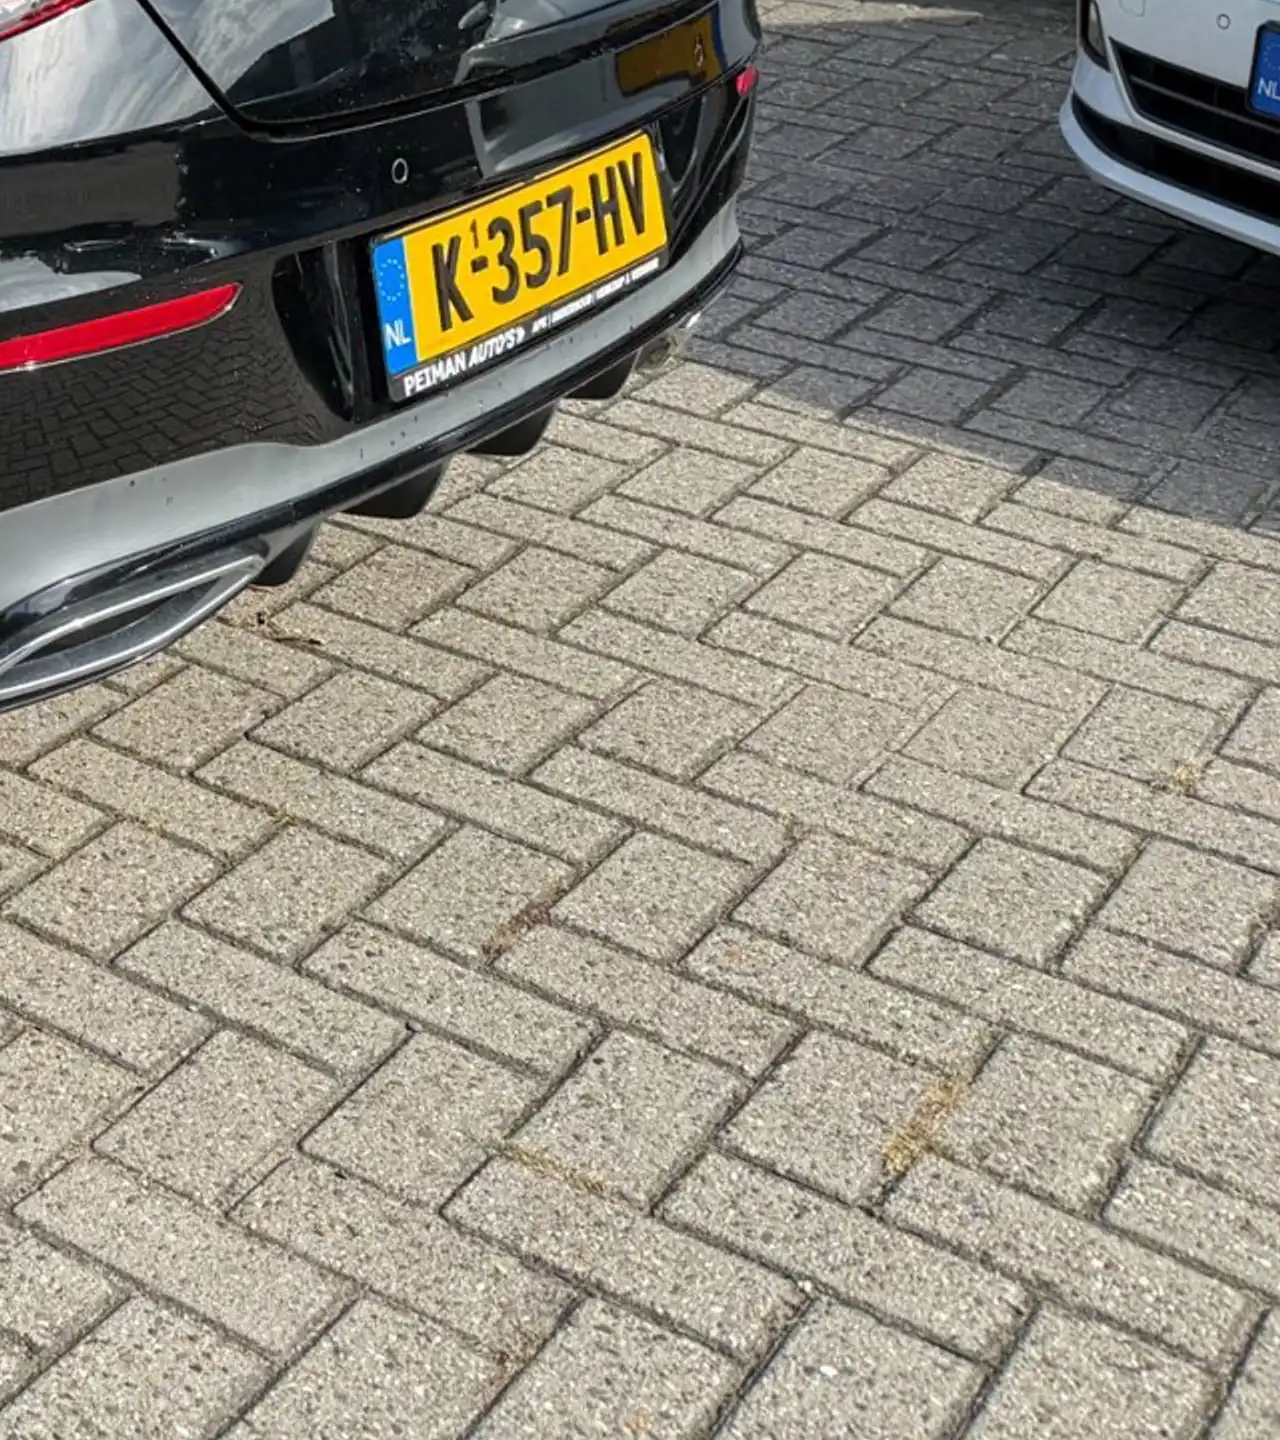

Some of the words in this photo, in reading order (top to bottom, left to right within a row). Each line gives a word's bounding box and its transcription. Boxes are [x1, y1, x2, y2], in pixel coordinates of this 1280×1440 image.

[430, 151, 646, 332] K-357-HV
[384, 320, 412, 350] NL
[403, 352, 467, 397] PEIMAN
